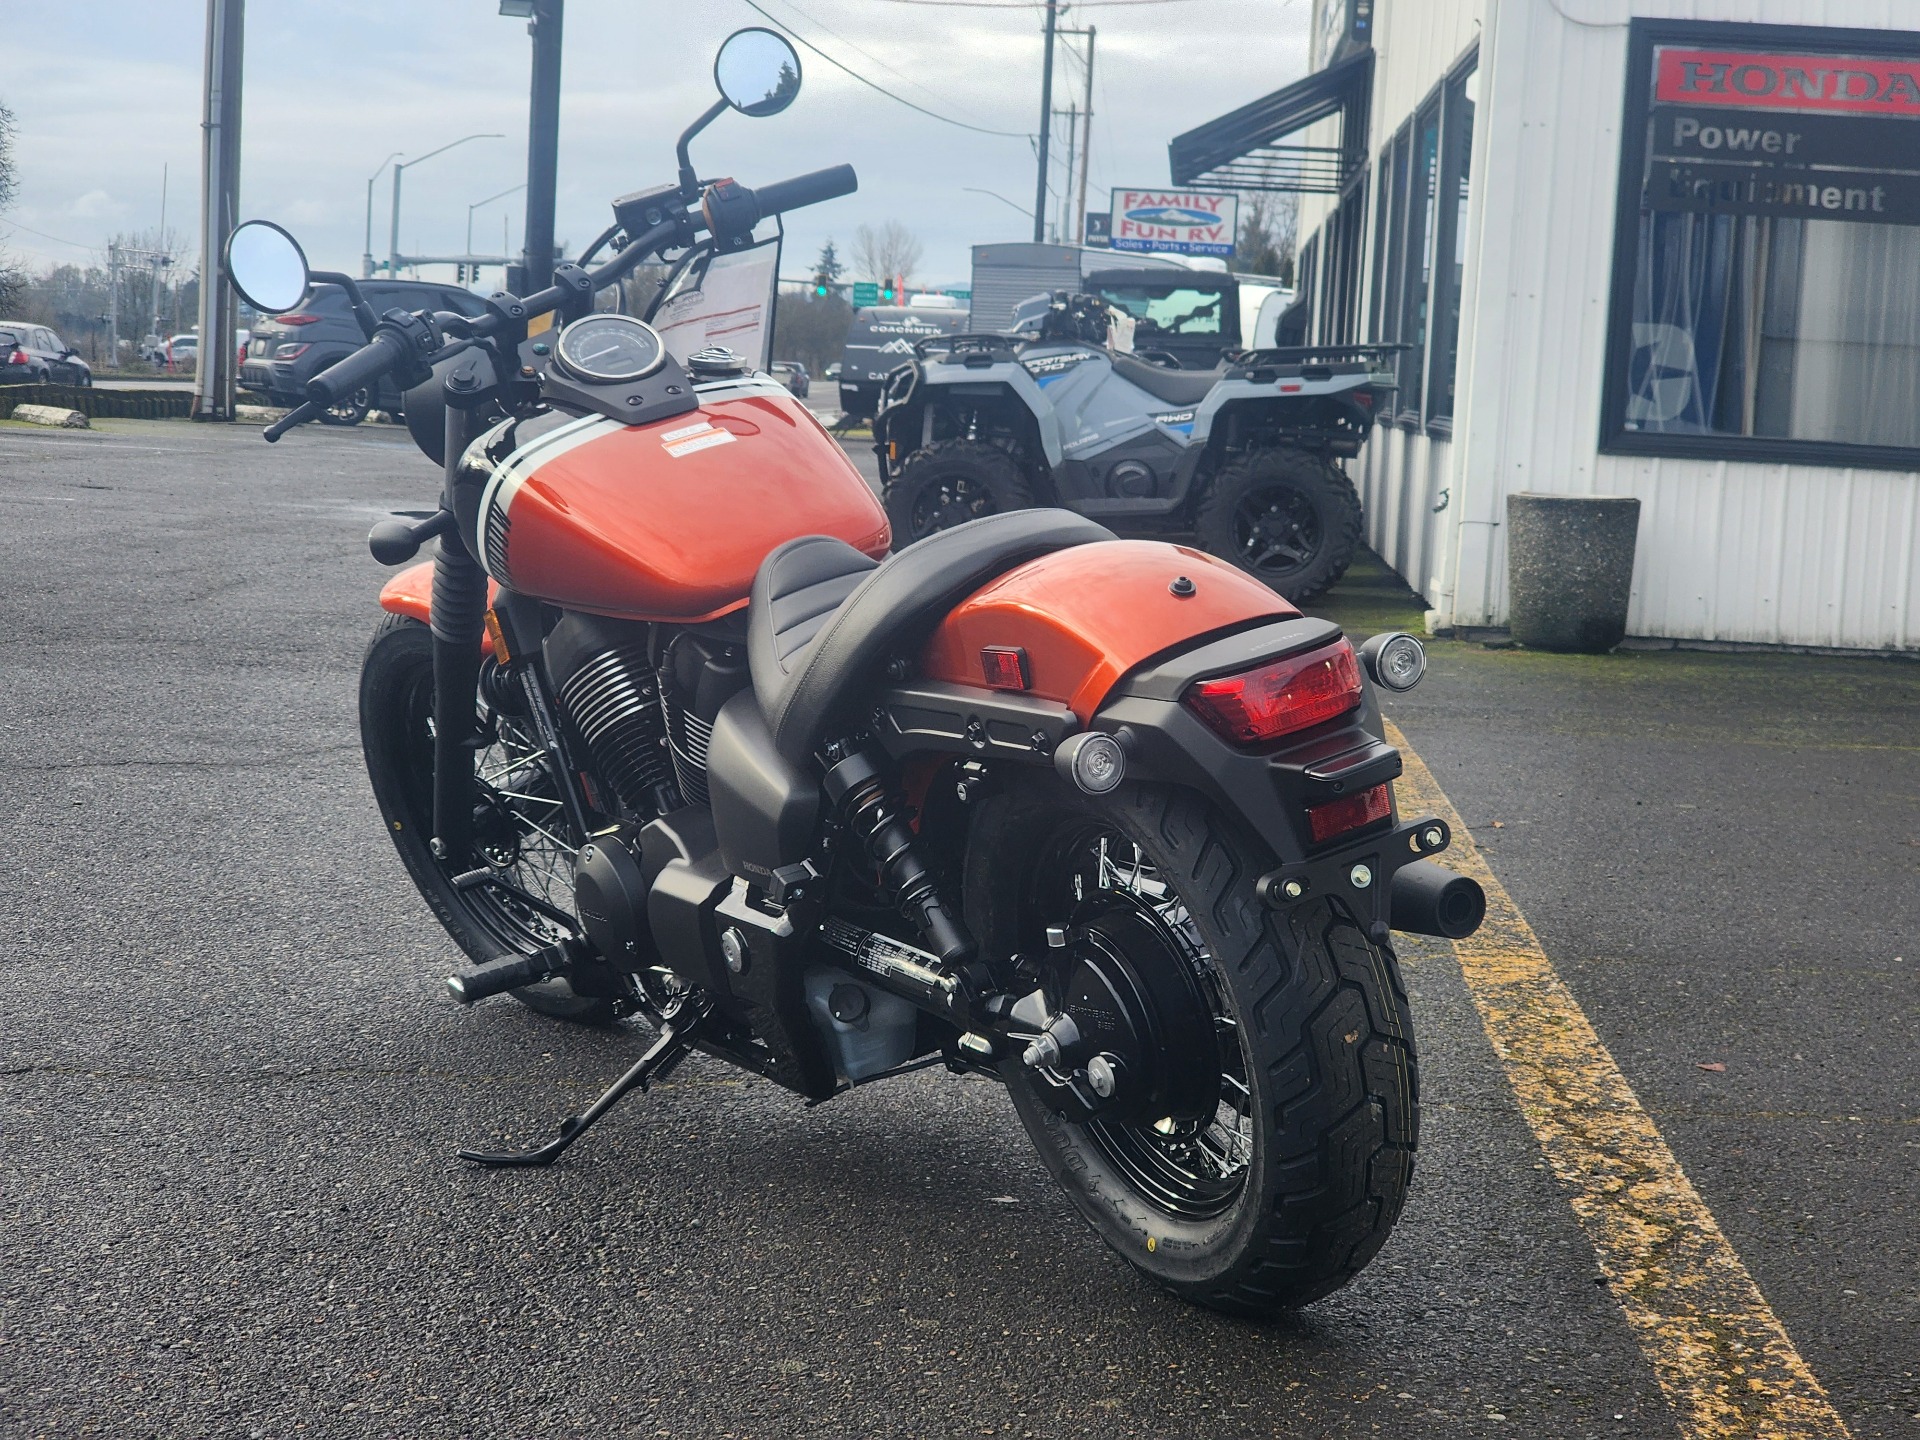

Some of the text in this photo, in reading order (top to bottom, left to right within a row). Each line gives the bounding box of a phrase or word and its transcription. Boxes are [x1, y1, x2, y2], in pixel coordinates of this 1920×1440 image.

[1678, 61, 1920, 104] HONDA
[1672, 116, 1802, 154] Power
[1669, 168, 1887, 213] quiment
[1123, 192, 1225, 213] FAMILY
[1120, 220, 1225, 242] FUN RV
[1115, 239, 1229, 254] Sales Parts Service
[869, 325, 942, 335] COACHMEN
[1155, 413, 1194, 424] AWD
[1063, 432, 1099, 450] POLARIS
[742, 860, 772, 877] HONDA
